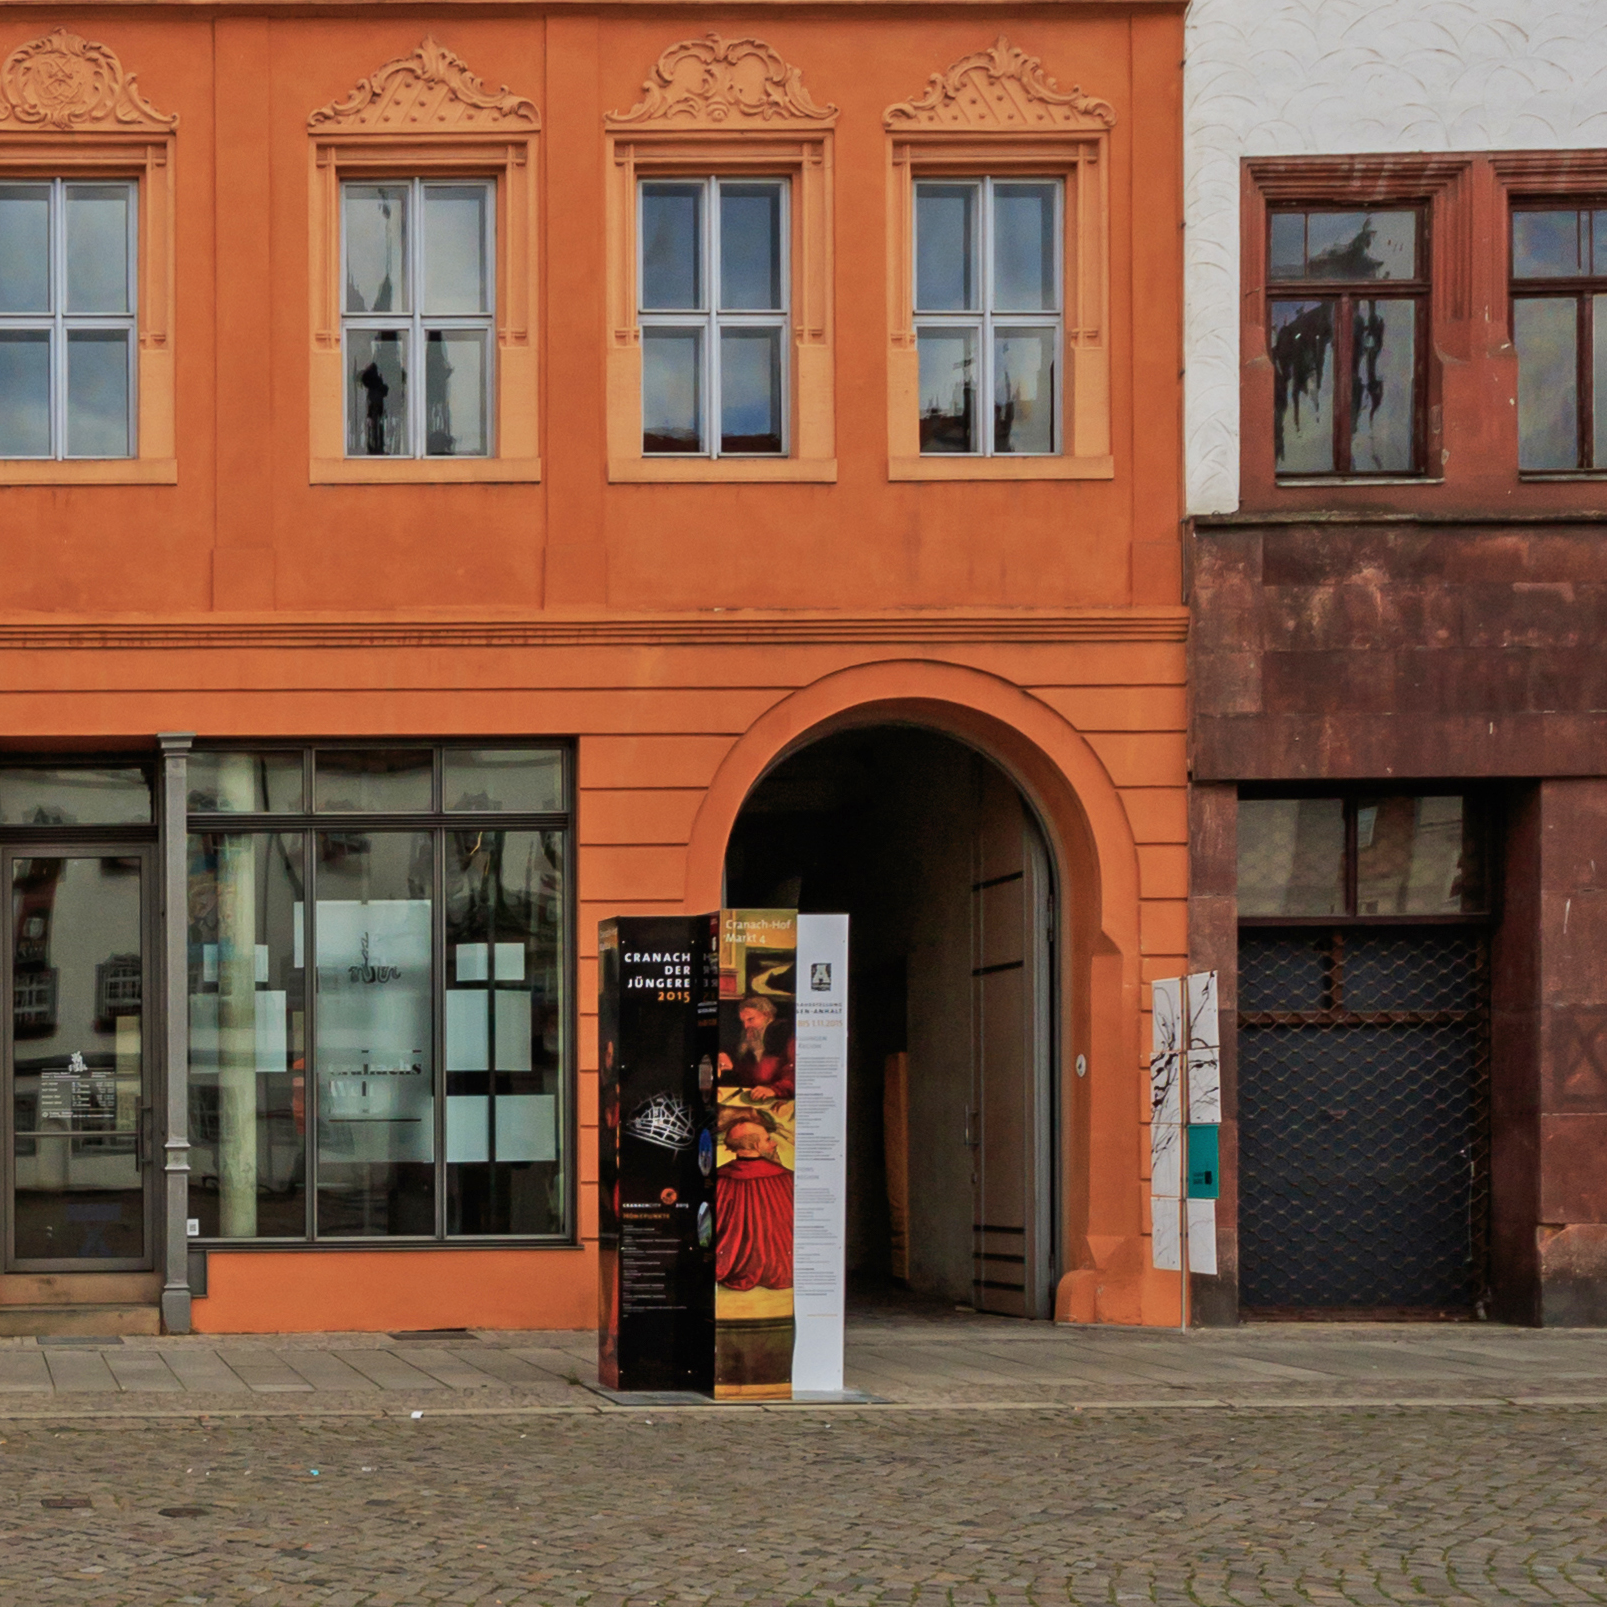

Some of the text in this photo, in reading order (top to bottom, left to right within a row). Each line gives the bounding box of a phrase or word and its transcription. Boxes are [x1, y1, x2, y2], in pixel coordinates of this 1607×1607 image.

[725, 919, 792, 930] Cranach-Hof
[725, 933, 766, 944] Markt 4
[624, 952, 691, 963] CRANACH
[664, 965, 691, 975] DER
[627, 975, 691, 988] JÜNGERE
[657, 991, 691, 1004] 2015
